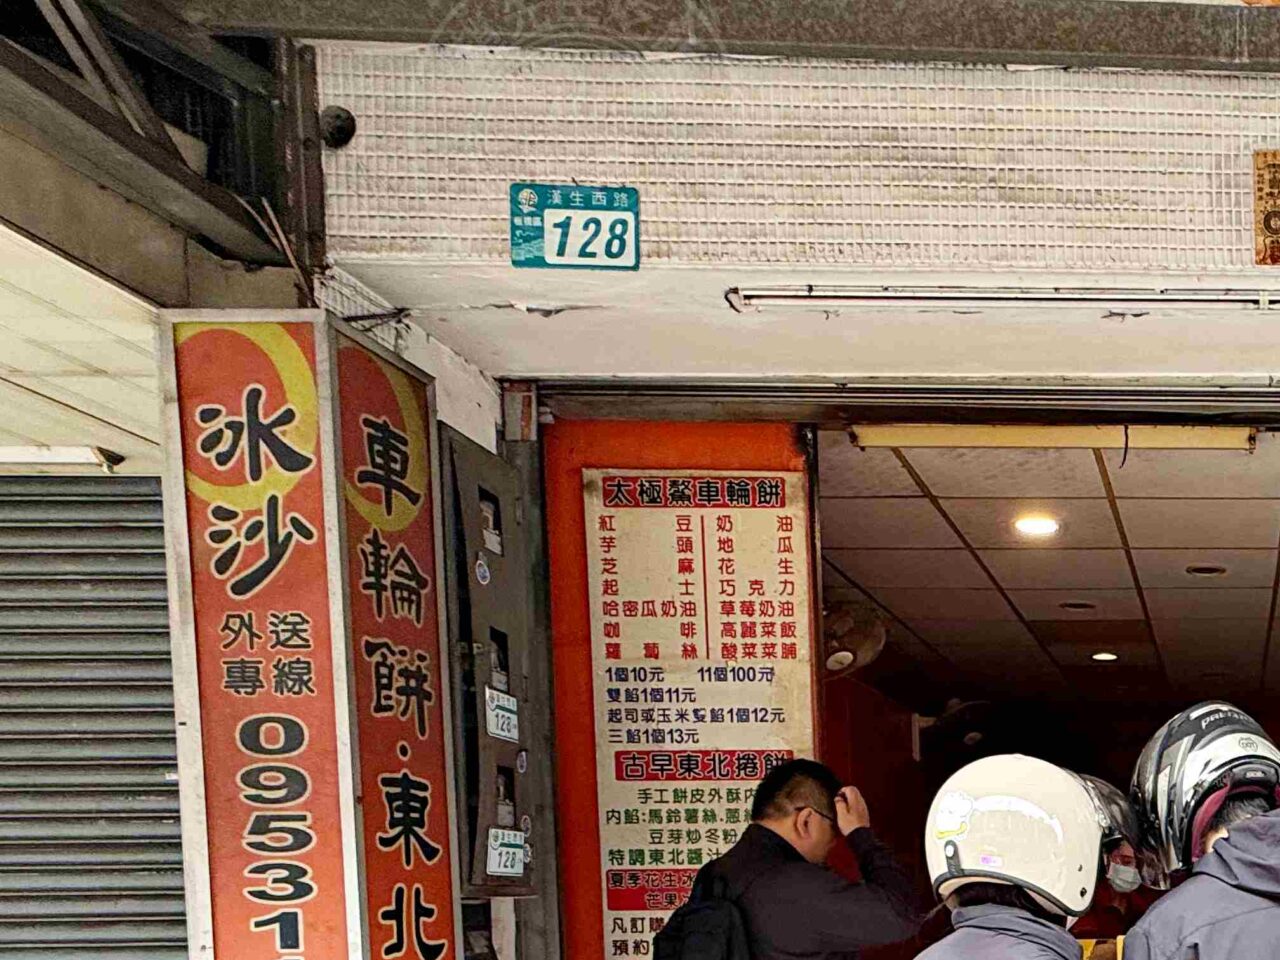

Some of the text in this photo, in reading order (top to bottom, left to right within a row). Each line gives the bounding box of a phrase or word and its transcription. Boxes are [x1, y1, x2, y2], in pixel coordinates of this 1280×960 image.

[547, 190, 629, 207] 漢生西路
[553, 215, 629, 259] 128
[197, 386, 314, 597] 冰沙
[719, 579, 795, 597] 巧克力
[603, 600, 697, 618] 哈密瓜奶油
[719, 600, 794, 617] 草莓奶油
[220, 614, 311, 651] 外送
[223, 659, 316, 697] 專線
[605, 666, 664, 682] 1個10元
[697, 666, 774, 683] 11個100元
[606, 687, 696, 703] 雙餡1個11元
[608, 728, 699, 744] 三餡1個13元
[622, 752, 787, 779] 古早東北捲餅
[648, 829, 737, 845] 豆芽炒冬粉
[612, 939, 650, 956] 預約
